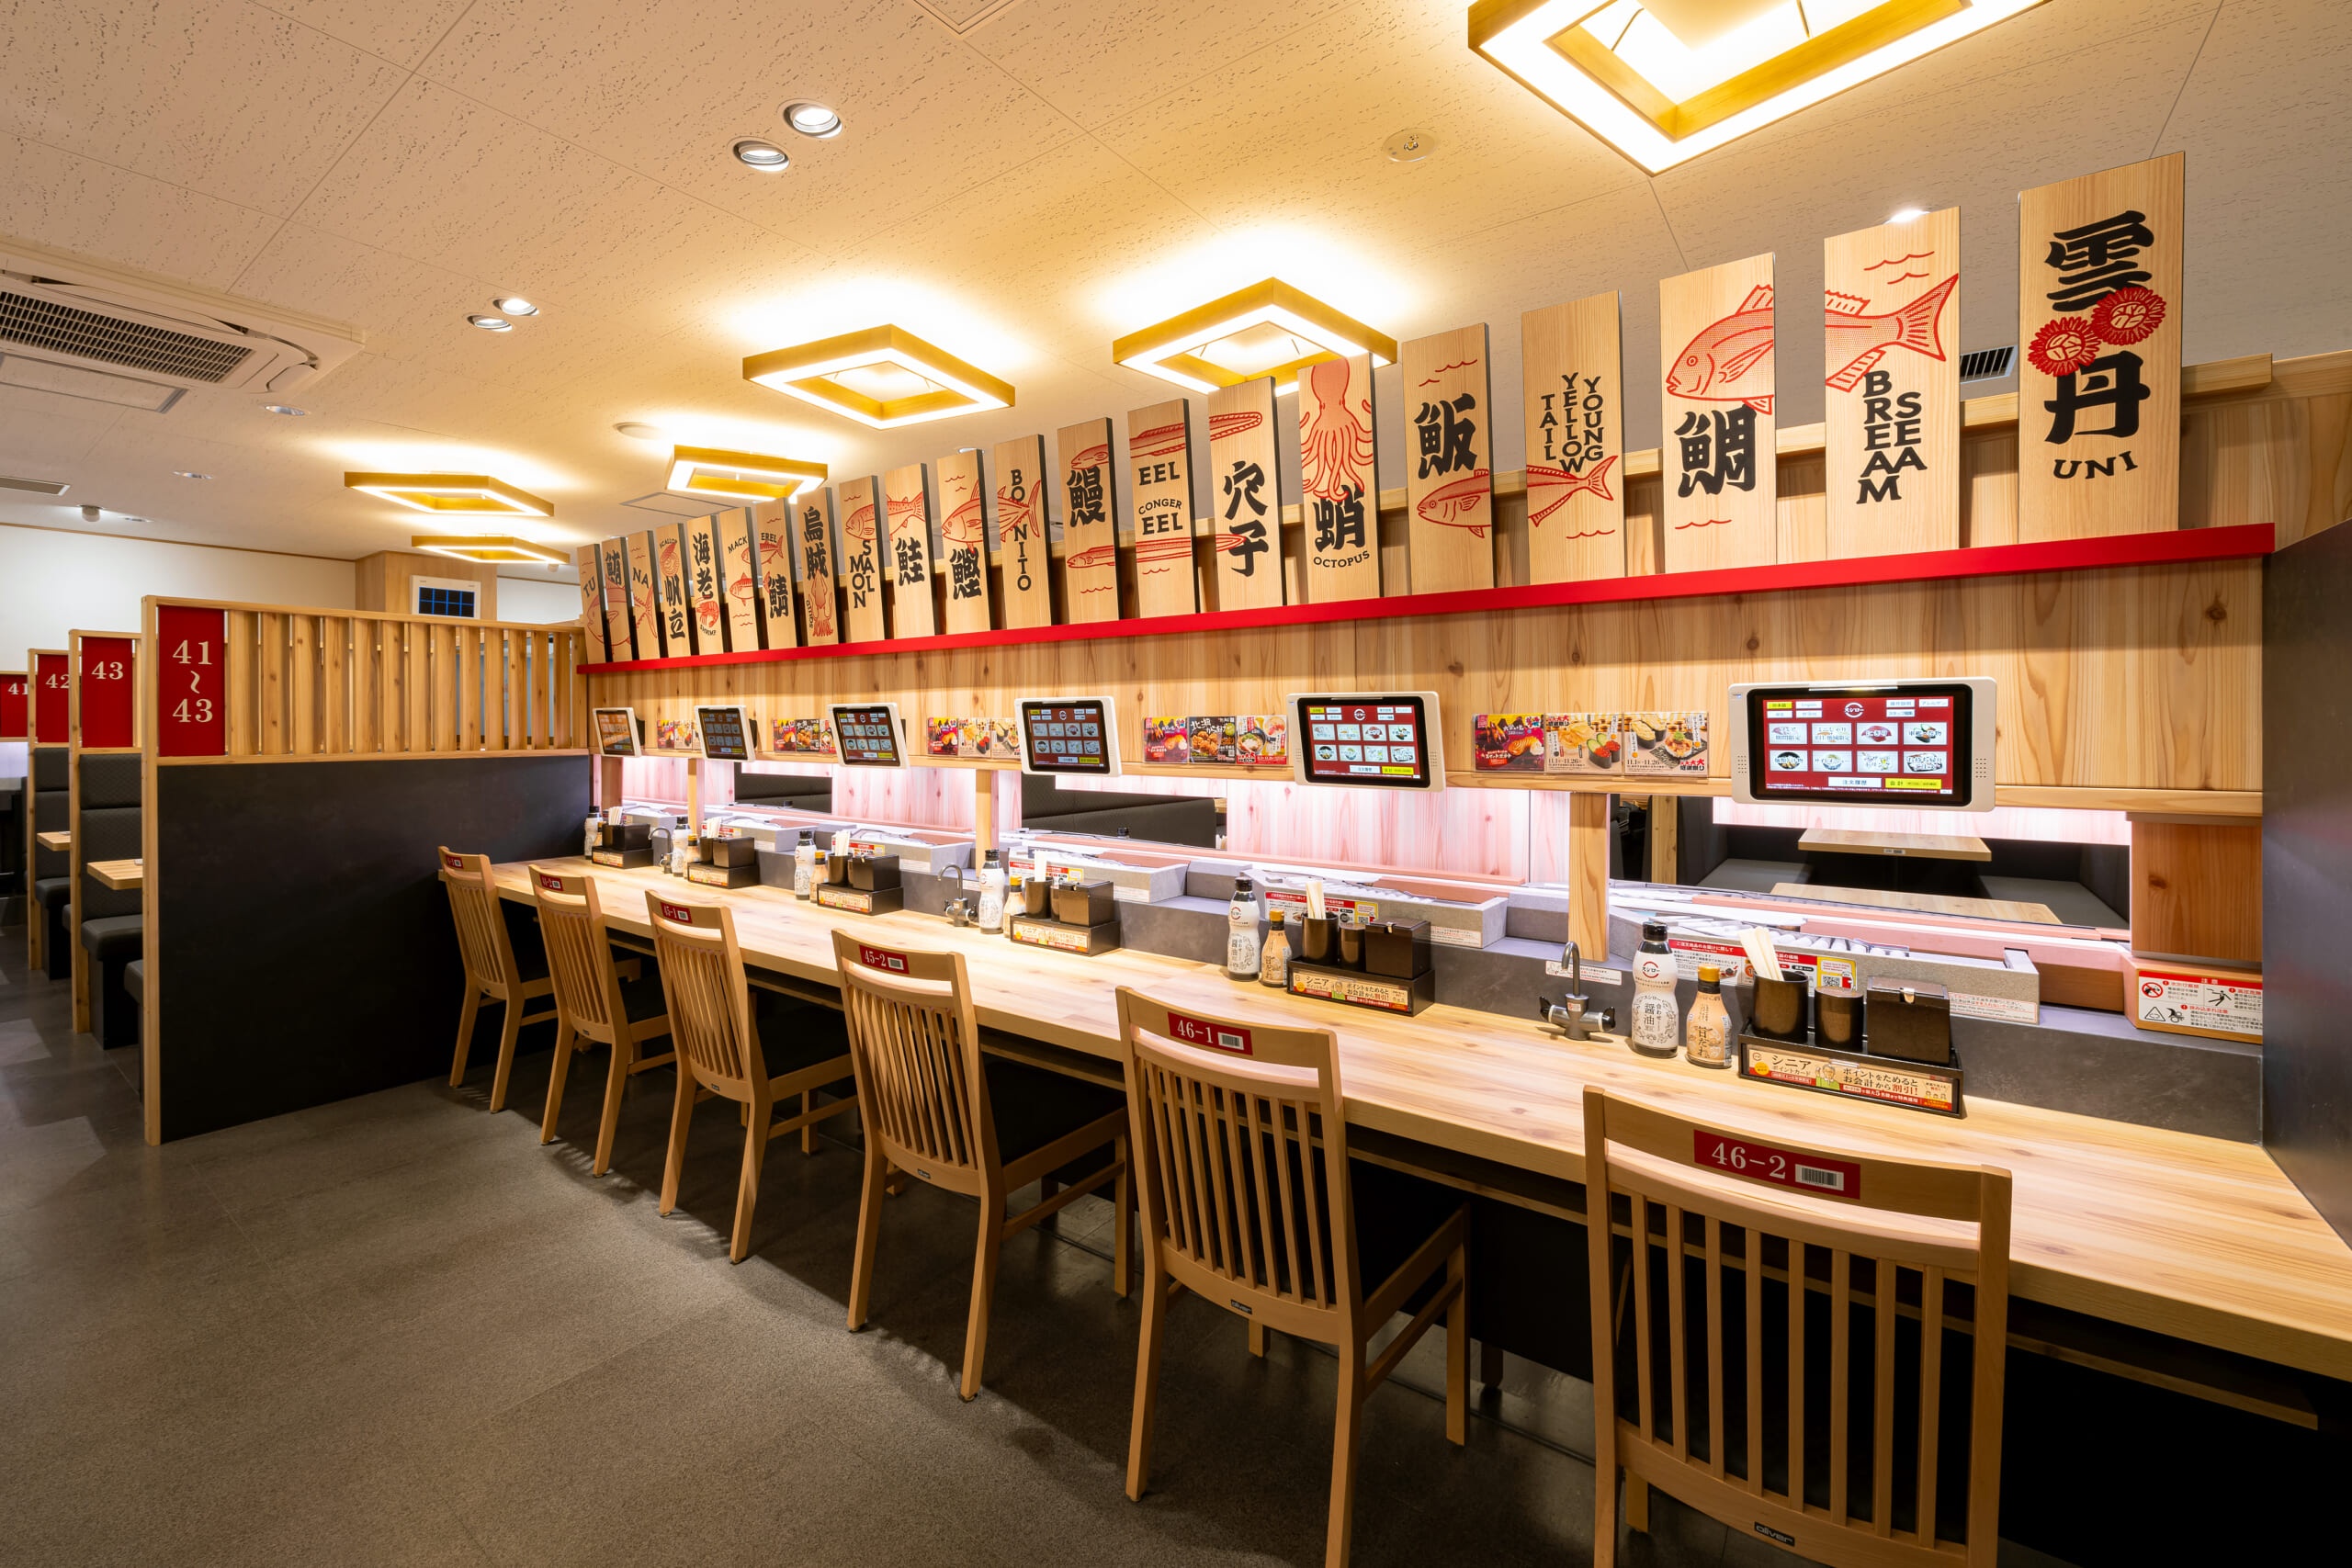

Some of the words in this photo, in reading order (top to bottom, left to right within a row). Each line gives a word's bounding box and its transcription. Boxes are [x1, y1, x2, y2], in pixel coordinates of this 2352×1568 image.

[2044, 209, 2154, 445] 雲丹
[1540, 393, 1559, 461] TAIL
[1559, 371, 1585, 473] YELLOW
[1583, 376, 1605, 462] YOUNG
[1892, 391, 1928, 471] SEA
[1674, 402, 1757, 498] 鯛
[1856, 369, 1903, 504] BREAM
[1138, 461, 1181, 486] EEL
[2052, 450, 2139, 479] UNI
[1067, 466, 1106, 527] 鰻
[1138, 499, 1182, 515] CONGER
[1011, 469, 1032, 592] BONITO
[1142, 512, 1183, 536] EEL
[1223, 460, 1269, 577] 穴子
[1313, 482, 1365, 552] 蛸
[728, 536, 748, 554] MACK
[761, 532, 777, 543] EREL
[693, 532, 714, 599] 海老
[895, 536, 925, 586] 鮭
[1313, 550, 1370, 569] OCTOPUS
[583, 575, 596, 598] TU
[632, 567, 650, 589] NA
[664, 573, 685, 638] 帆立
[768, 573, 789, 618] 鯖
[173, 639, 212, 665] 41
[46, 673, 70, 689] 42
[91, 660, 124, 680] 43
[172, 698, 213, 723] 43
[865, 950, 887, 967] 45-2
[1177, 1020, 1214, 1043] 46-1
[1772, 1055, 1811, 1070] シニア
[1843, 1067, 1918, 1088] ポイントをためると
[1712, 1142, 1786, 1179] 46-2
[1756, 1524, 1793, 1543] oliver
